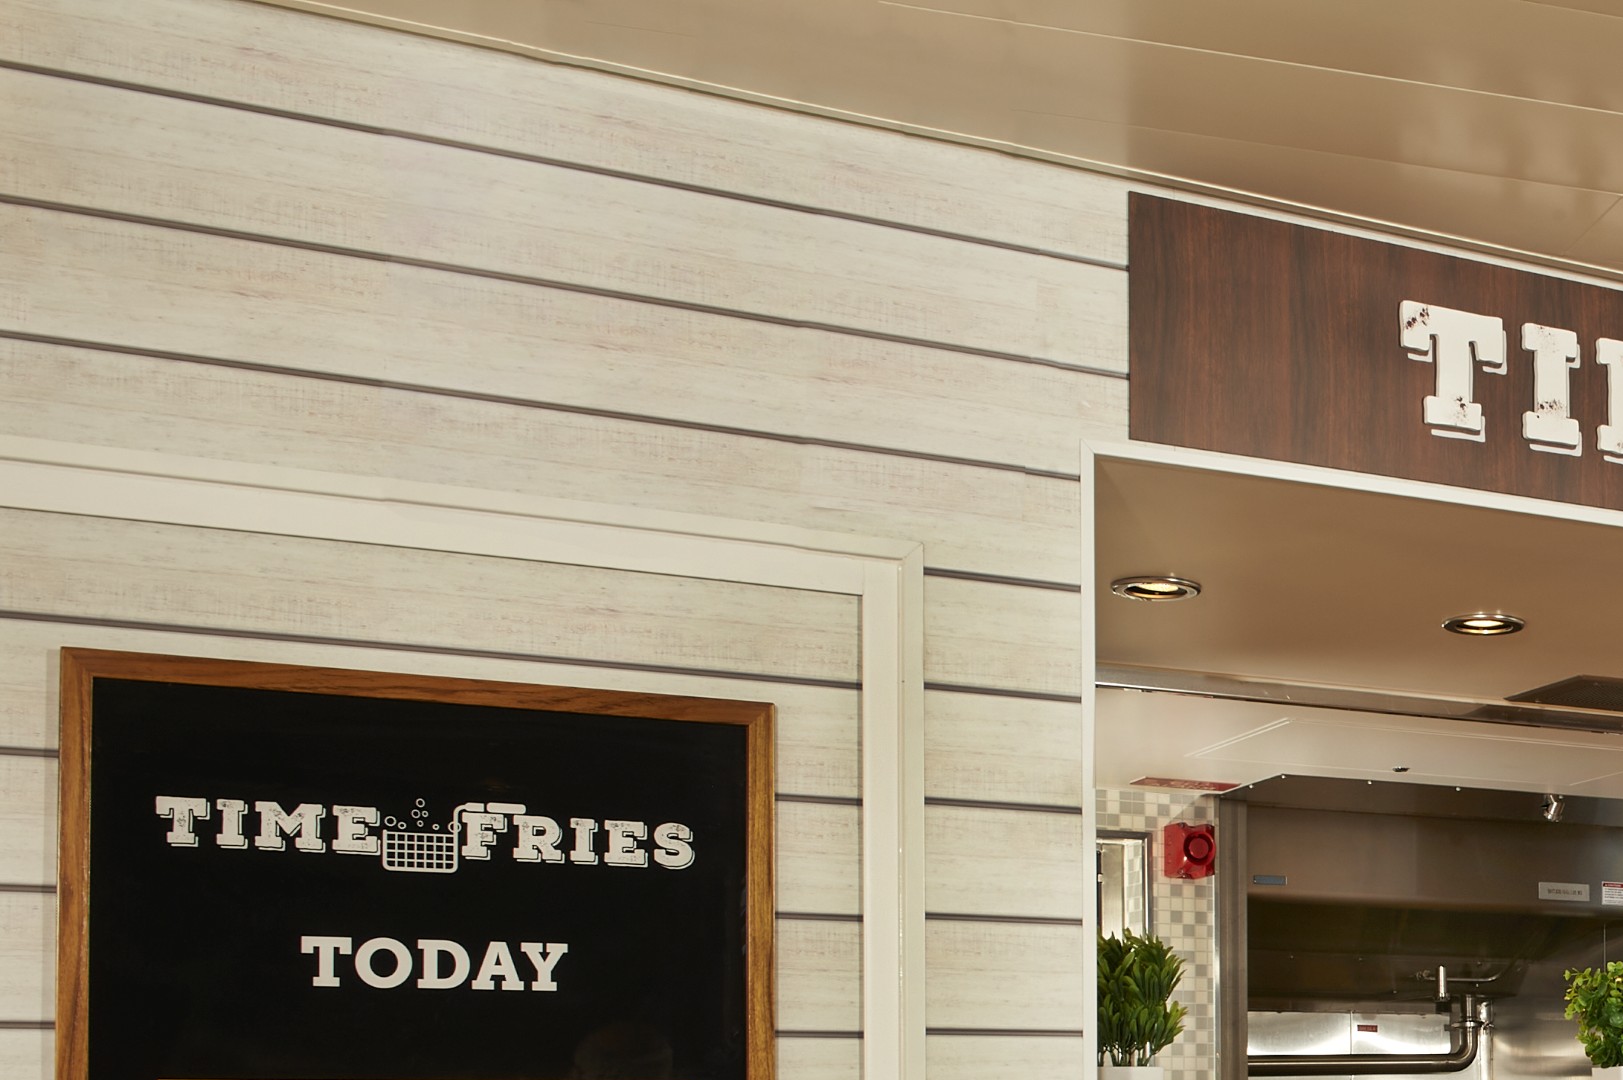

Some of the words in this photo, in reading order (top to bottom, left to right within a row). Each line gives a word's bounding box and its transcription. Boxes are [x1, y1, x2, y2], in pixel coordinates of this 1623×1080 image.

[155, 795, 383, 855] TIME
[461, 811, 697, 871] FRIES
[300, 935, 569, 992] TODAY
